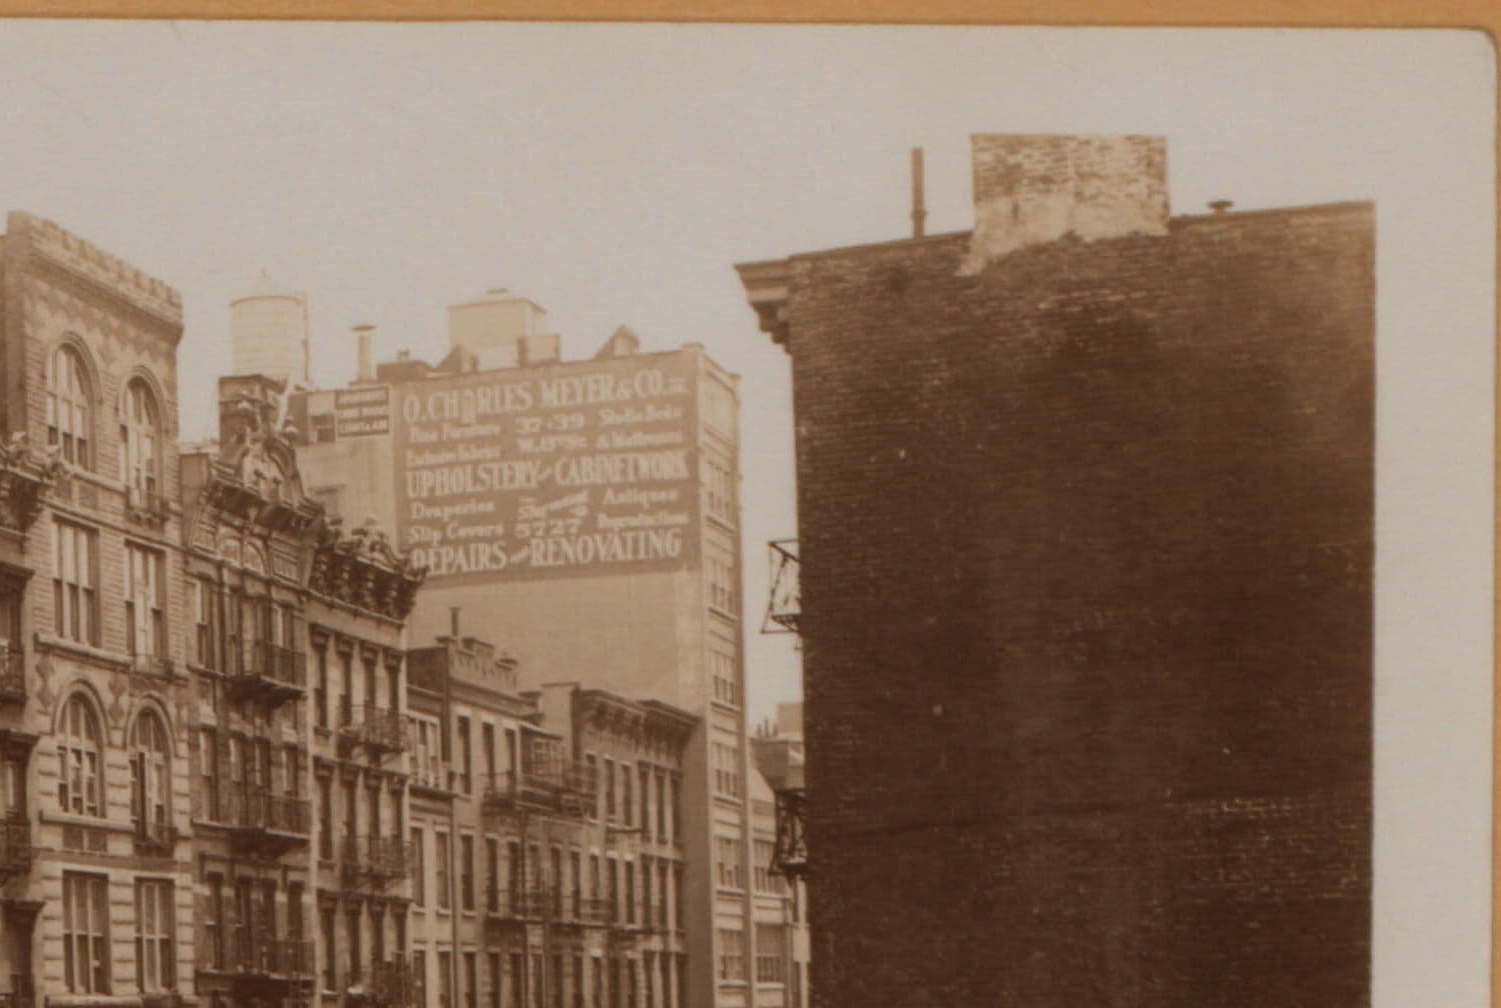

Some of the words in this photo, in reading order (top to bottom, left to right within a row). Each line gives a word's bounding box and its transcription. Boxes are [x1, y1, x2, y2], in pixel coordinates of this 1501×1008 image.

[539, 375, 614, 409] MEYER
[406, 460, 541, 500] UPHOLSTERY
[554, 453, 689, 487] CABINETWORK
[411, 541, 507, 577] REPAIRS
[530, 527, 681, 567] RENOVATING
